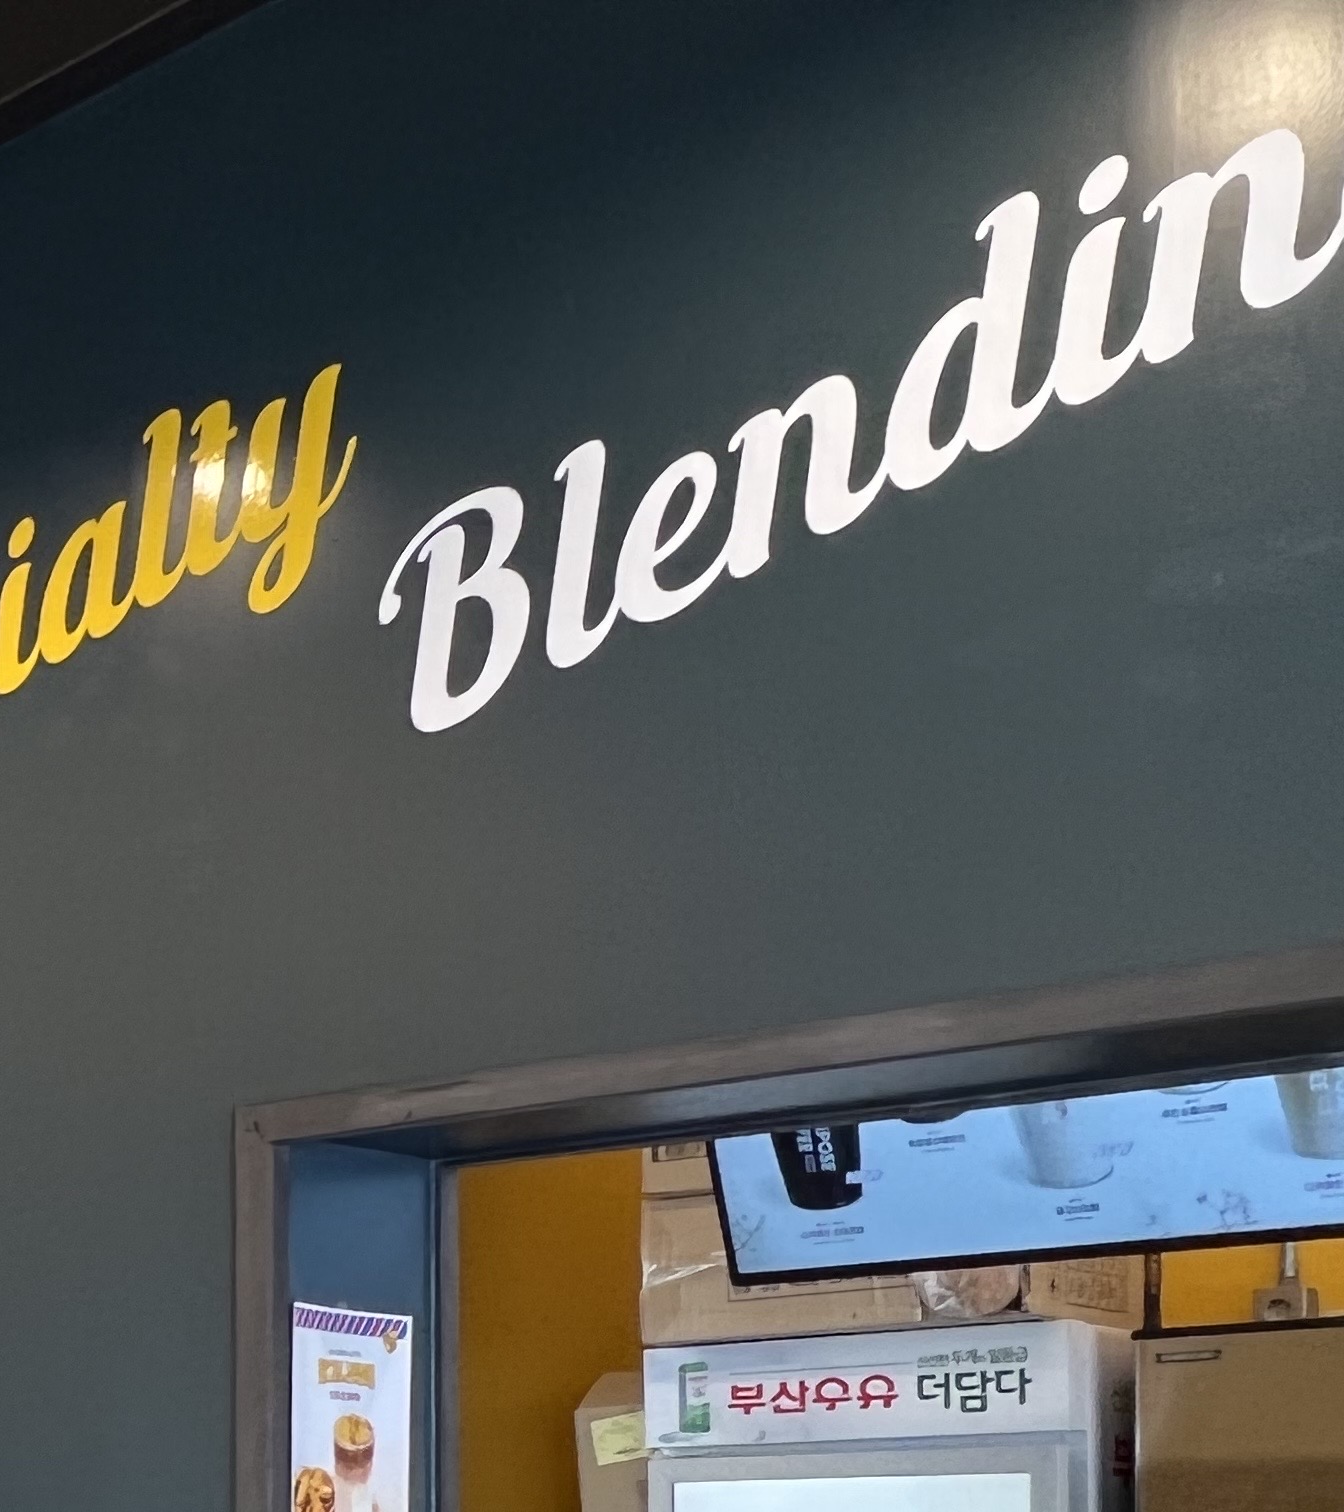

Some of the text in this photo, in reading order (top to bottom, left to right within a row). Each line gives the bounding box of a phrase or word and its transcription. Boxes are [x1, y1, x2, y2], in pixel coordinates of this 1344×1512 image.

[378, 127, 1344, 735] Blendin
[727, 1368, 1032, 1414] 부산우유 더담다
